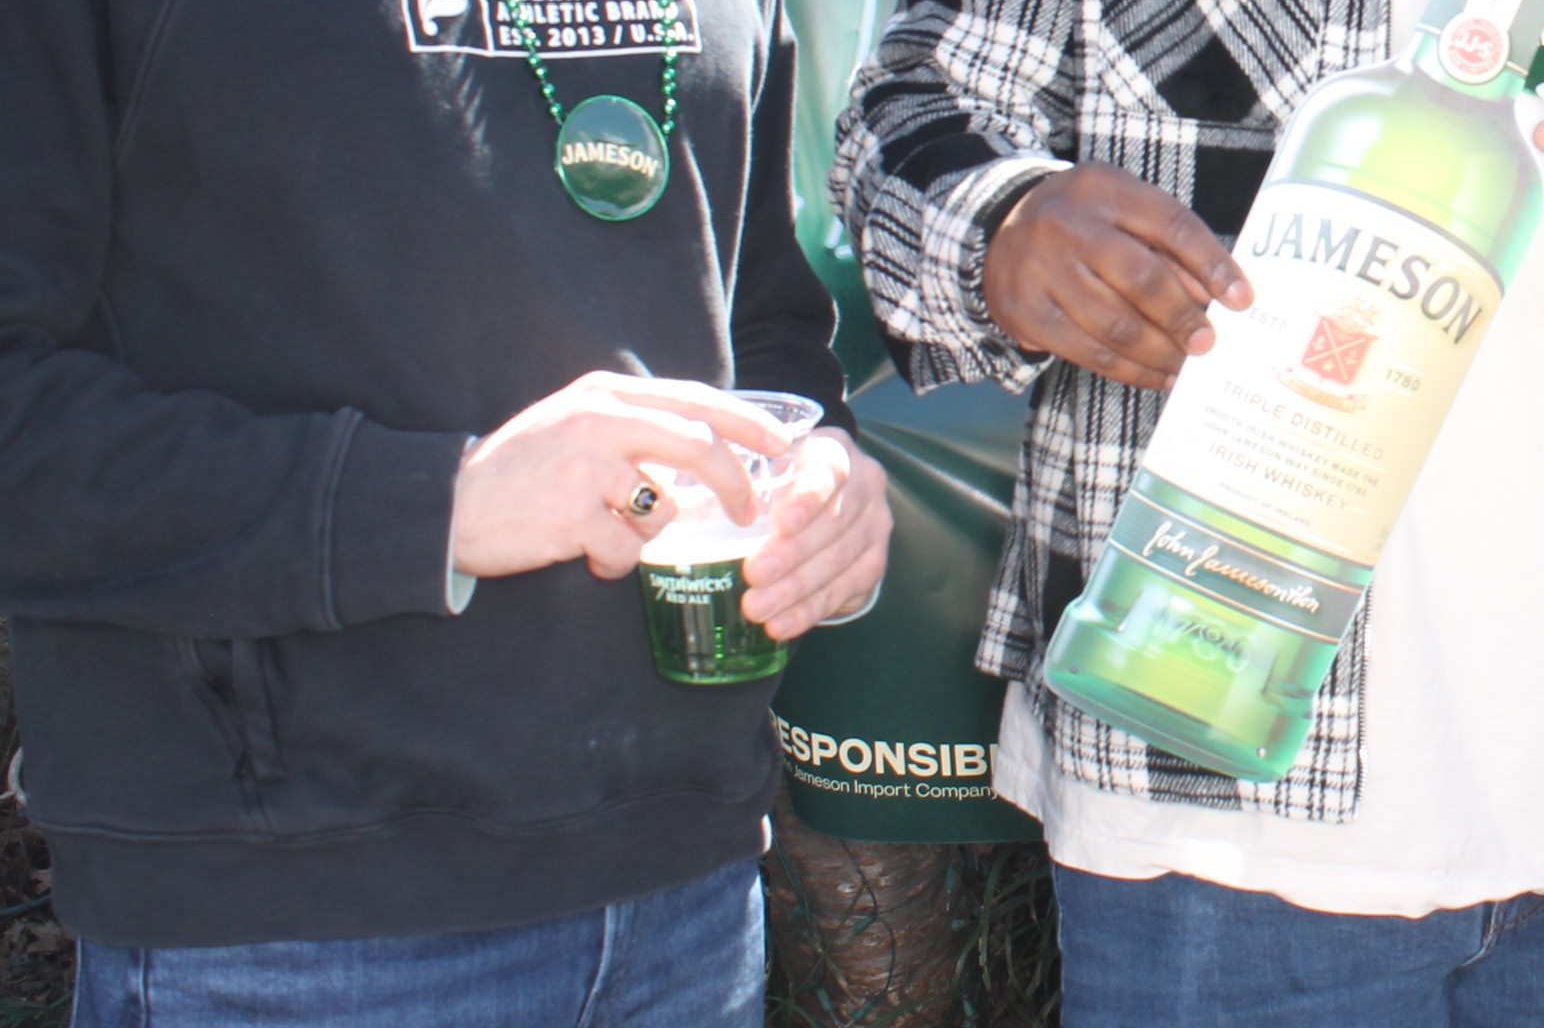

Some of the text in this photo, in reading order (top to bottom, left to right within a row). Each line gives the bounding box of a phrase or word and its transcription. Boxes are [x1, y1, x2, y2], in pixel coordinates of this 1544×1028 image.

[496, 0, 600, 24] AHLETIC
[498, 25, 542, 47] ES.
[547, 24, 606, 48] 2013
[629, 21, 695, 43] U.SA.
[560, 141, 659, 178] JAMESON
[1251, 212, 1483, 346] JAMESON
[1384, 367, 1422, 394] 1780
[1222, 379, 1286, 420] TRIPLE
[1290, 412, 1385, 462] DISTILLED
[1207, 439, 1351, 510] IRISH WHISKEY
[768, 705, 998, 777] ESPONSIB
[794, 764, 850, 793] Jameson
[854, 779, 911, 798] Import
